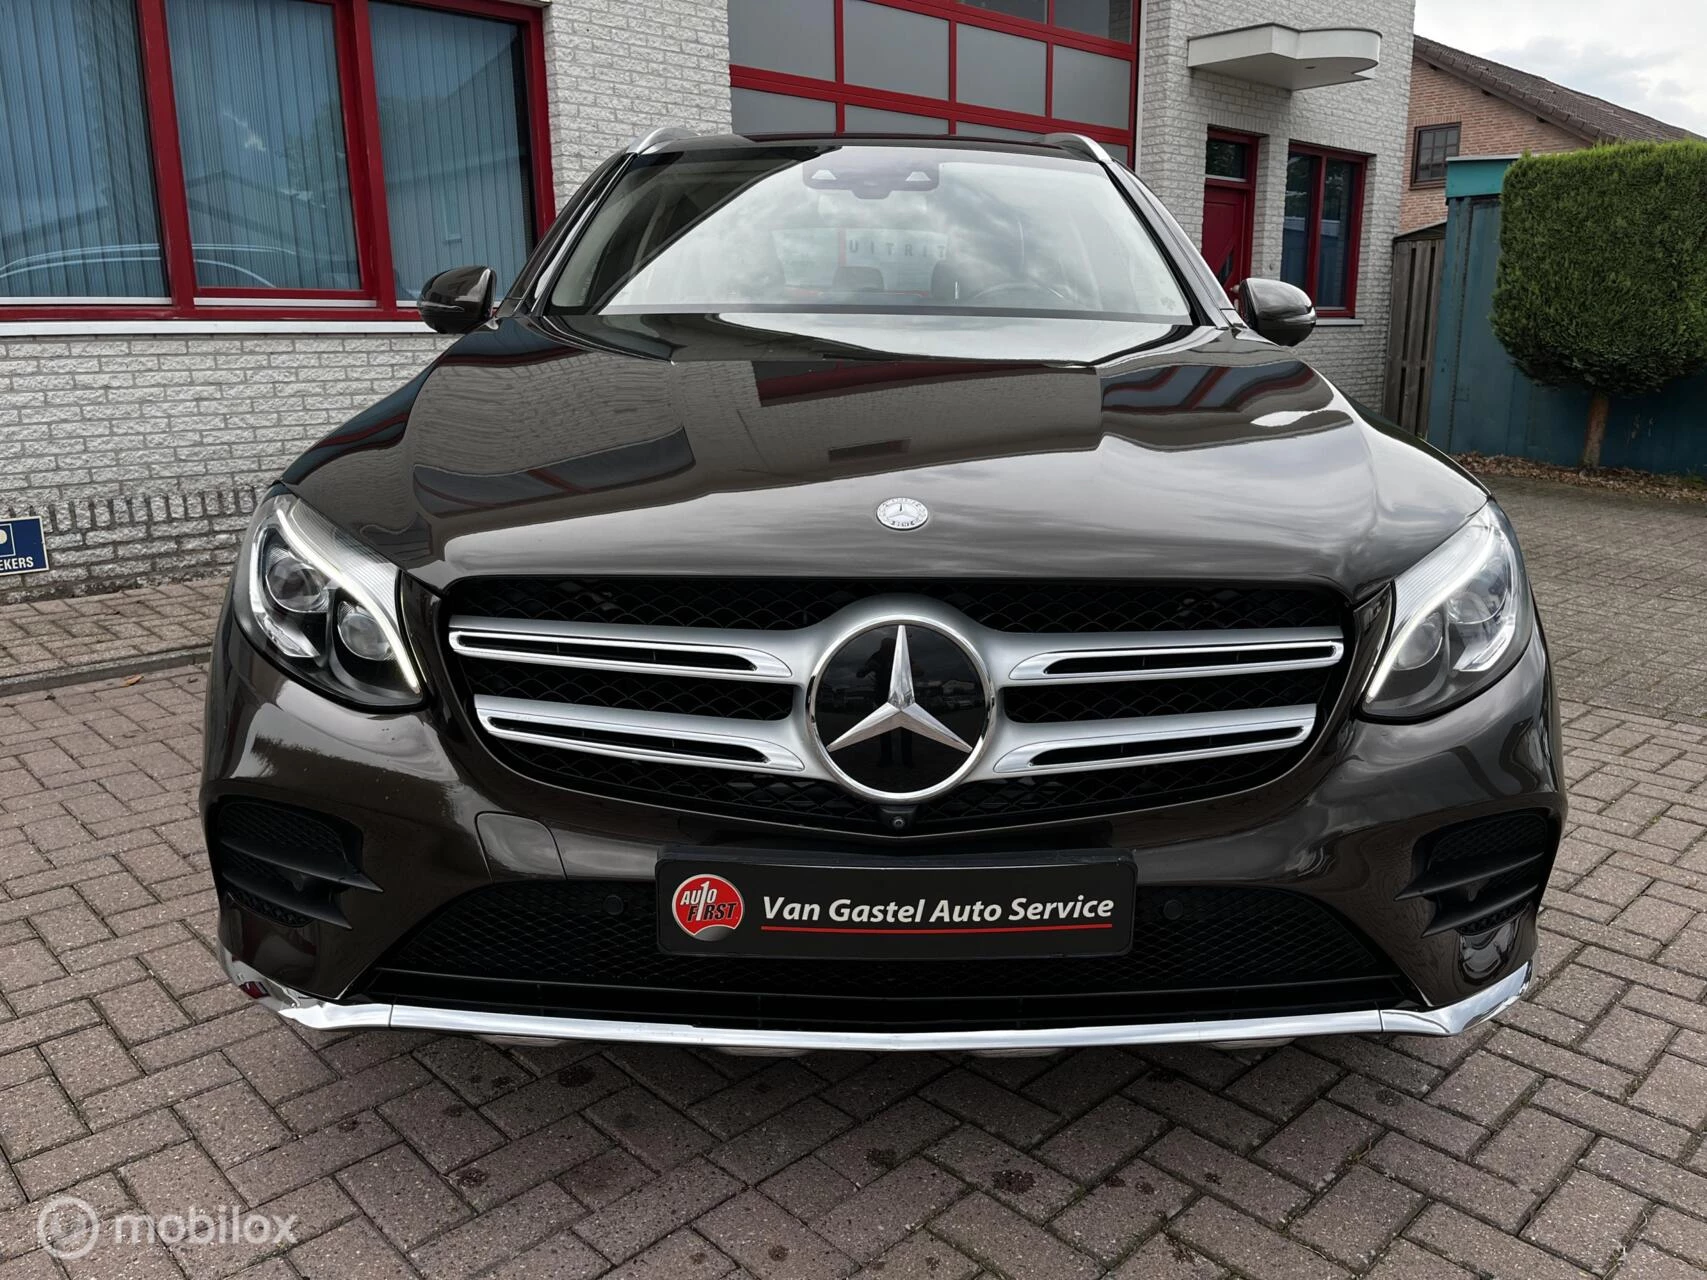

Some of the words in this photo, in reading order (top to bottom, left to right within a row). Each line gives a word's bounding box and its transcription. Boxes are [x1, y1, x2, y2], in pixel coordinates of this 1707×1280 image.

[763, 896, 821, 921] Van
[828, 899, 926, 923] Gastel
[929, 900, 1002, 923] Auto
[1008, 895, 1114, 921] Service
